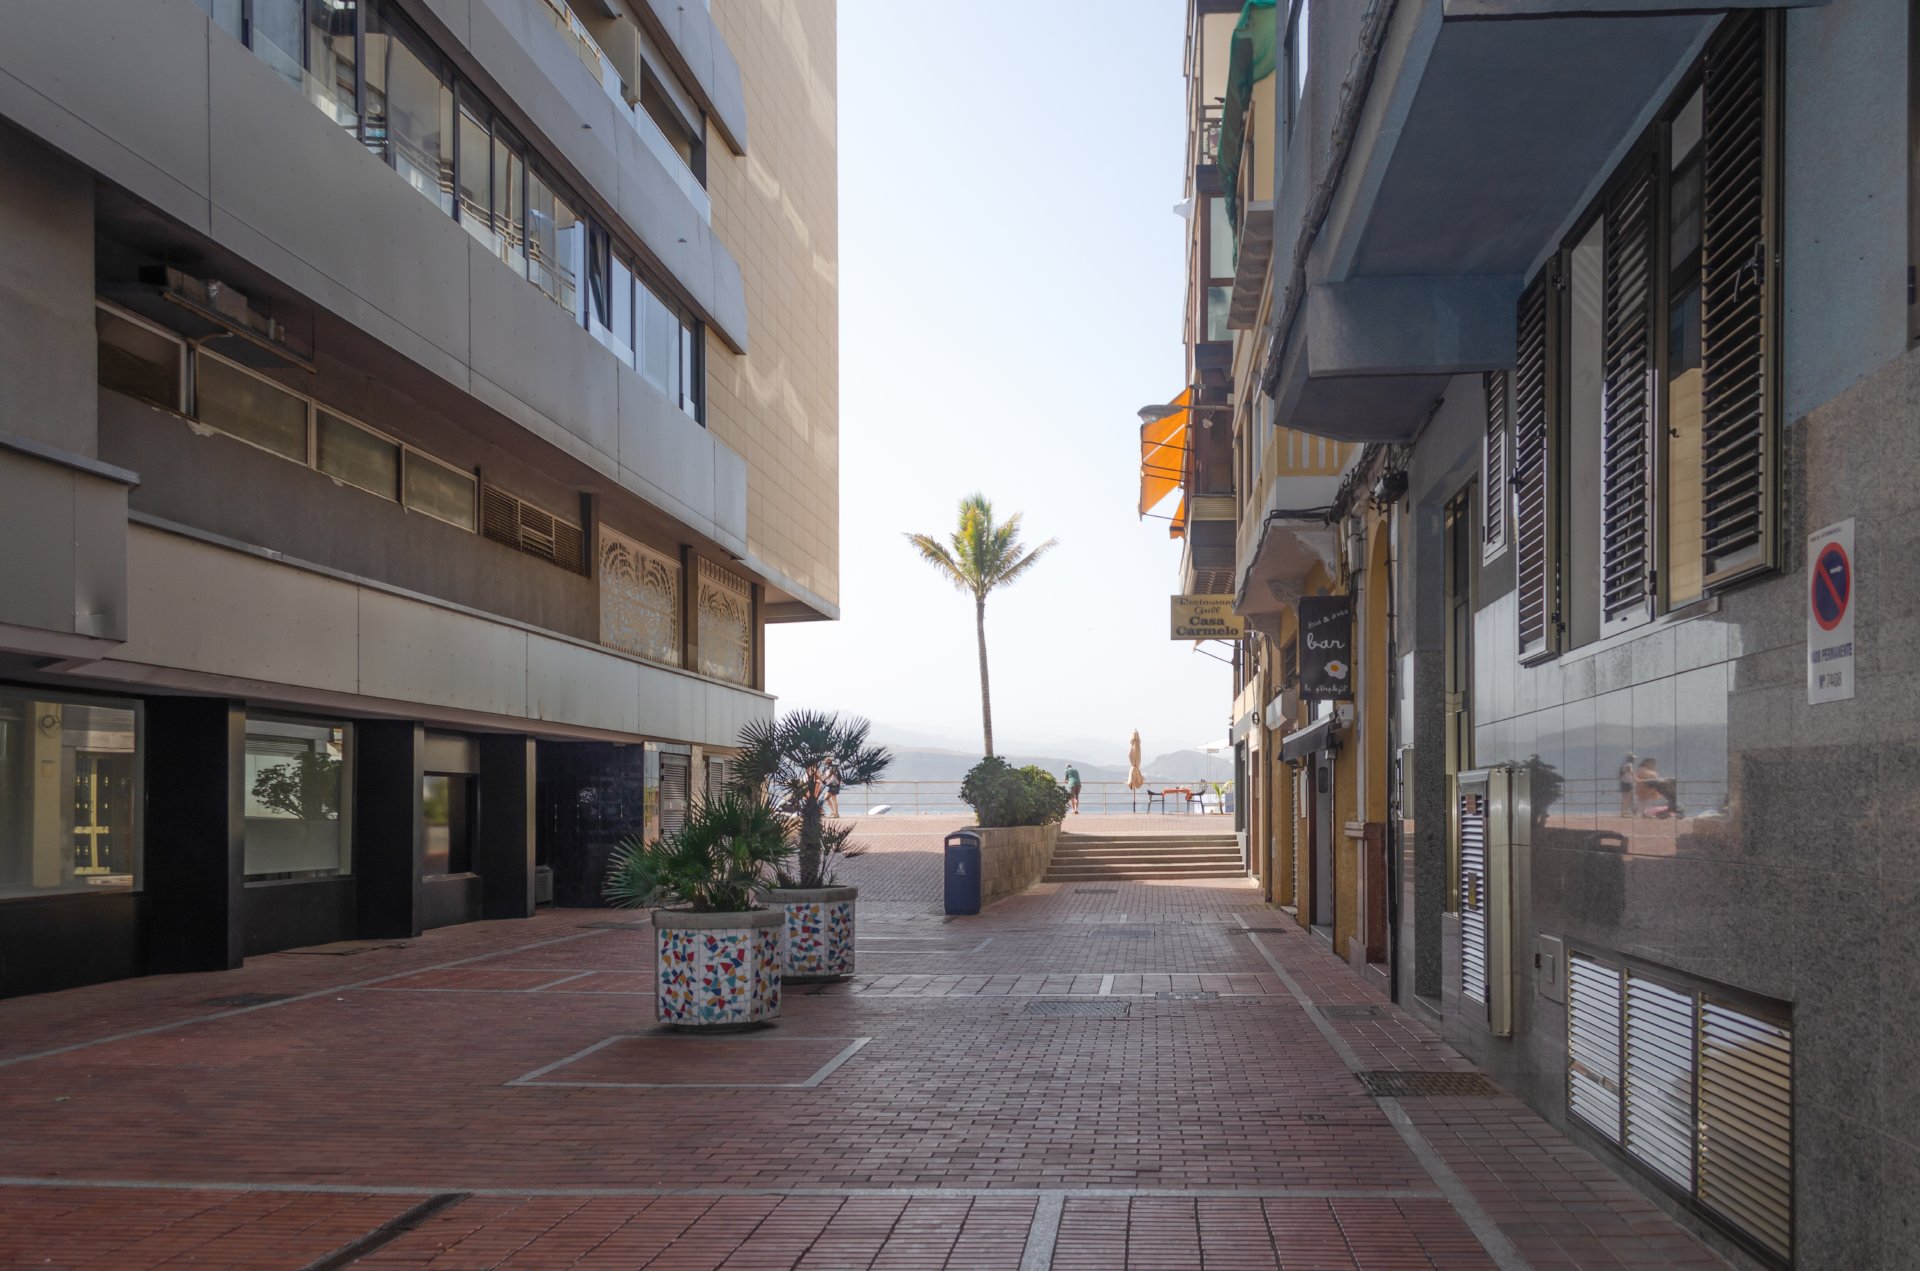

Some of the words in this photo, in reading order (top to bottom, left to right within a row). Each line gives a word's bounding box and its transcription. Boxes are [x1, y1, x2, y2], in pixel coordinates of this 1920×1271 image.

[1194, 606, 1220, 615] Grill
[1189, 616, 1225, 626] Casa
[1176, 626, 1239, 636] Carmelo
[1307, 632, 1346, 650] bar
